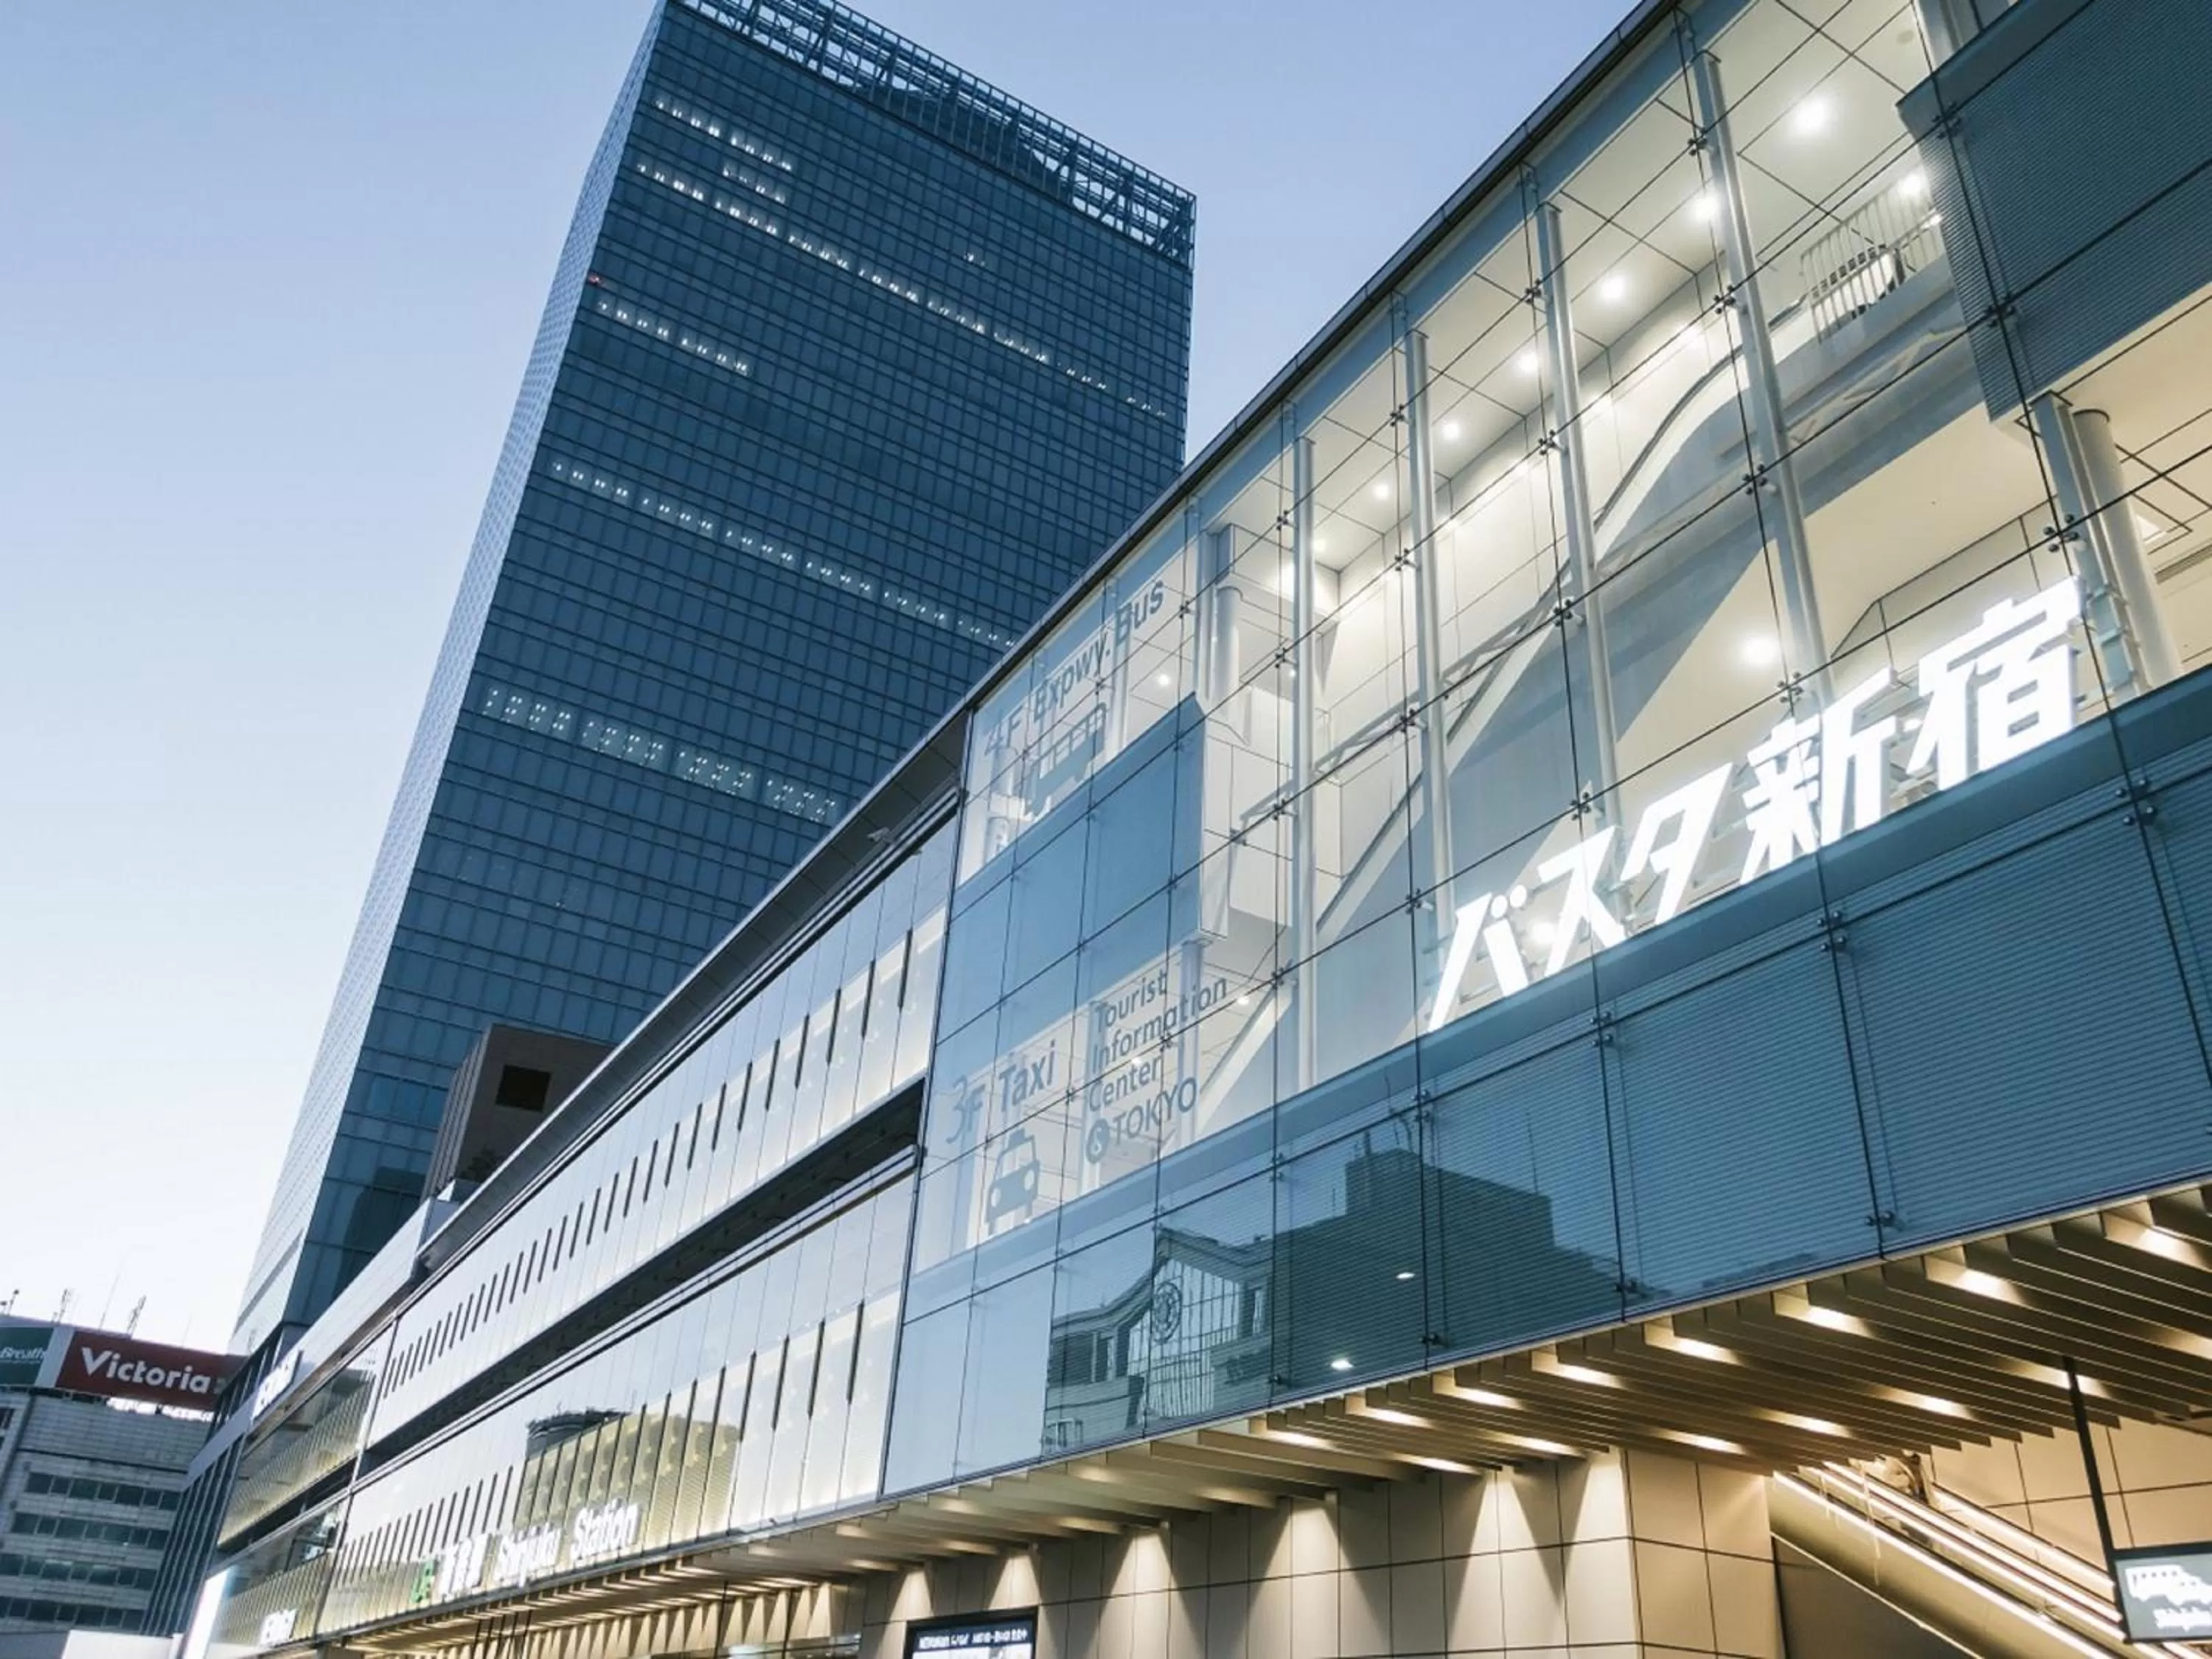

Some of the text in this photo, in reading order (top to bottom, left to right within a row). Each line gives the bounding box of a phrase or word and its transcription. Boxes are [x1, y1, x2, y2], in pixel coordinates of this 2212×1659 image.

[1116, 580, 1164, 647] Bus
[1427, 576, 2081, 1031] バスタ新宿
[1092, 969, 1168, 1032] Tourist
[1093, 978, 1227, 1074] Information
[945, 1039, 1055, 1144] 3F Taxi
[1089, 1055, 1163, 1111] Center
[1113, 1077, 1197, 1145] TOKYO
[81, 1347, 211, 1394] Victoria
